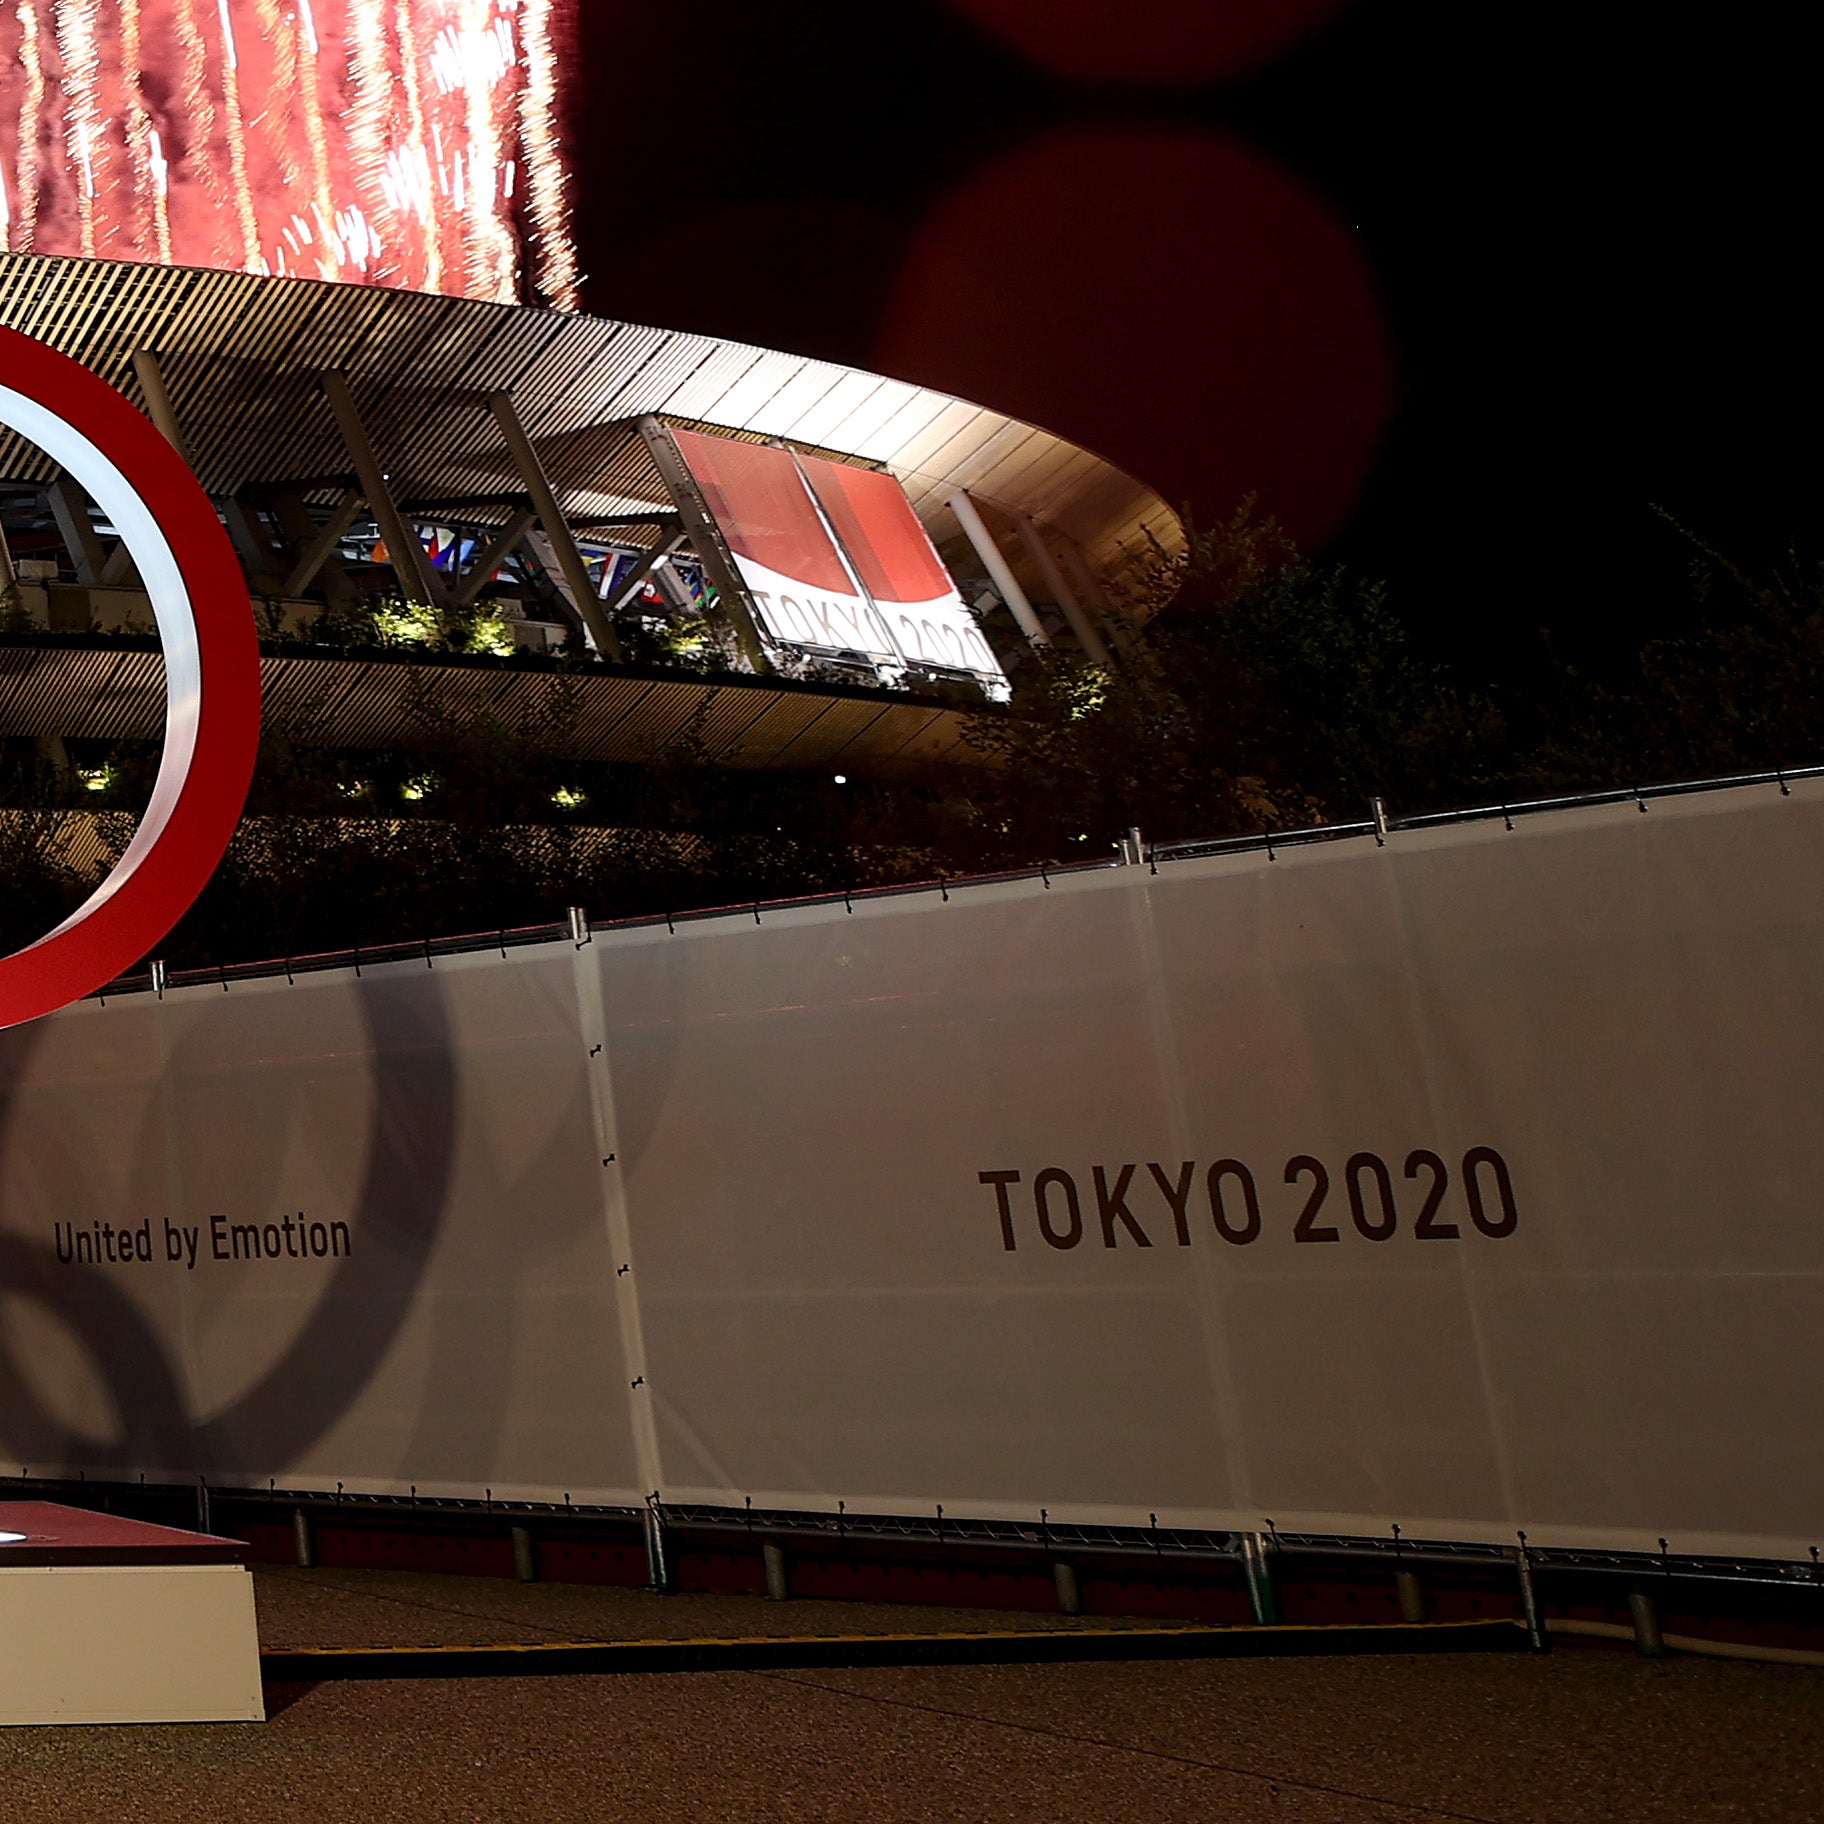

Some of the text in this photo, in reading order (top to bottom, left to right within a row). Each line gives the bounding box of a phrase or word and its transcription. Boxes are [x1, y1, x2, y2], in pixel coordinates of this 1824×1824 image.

[899, 614, 1001, 672] 2020
[978, 1146, 1518, 1251] TOKYO 2020
[54, 1212, 351, 1270] United by Emotion
